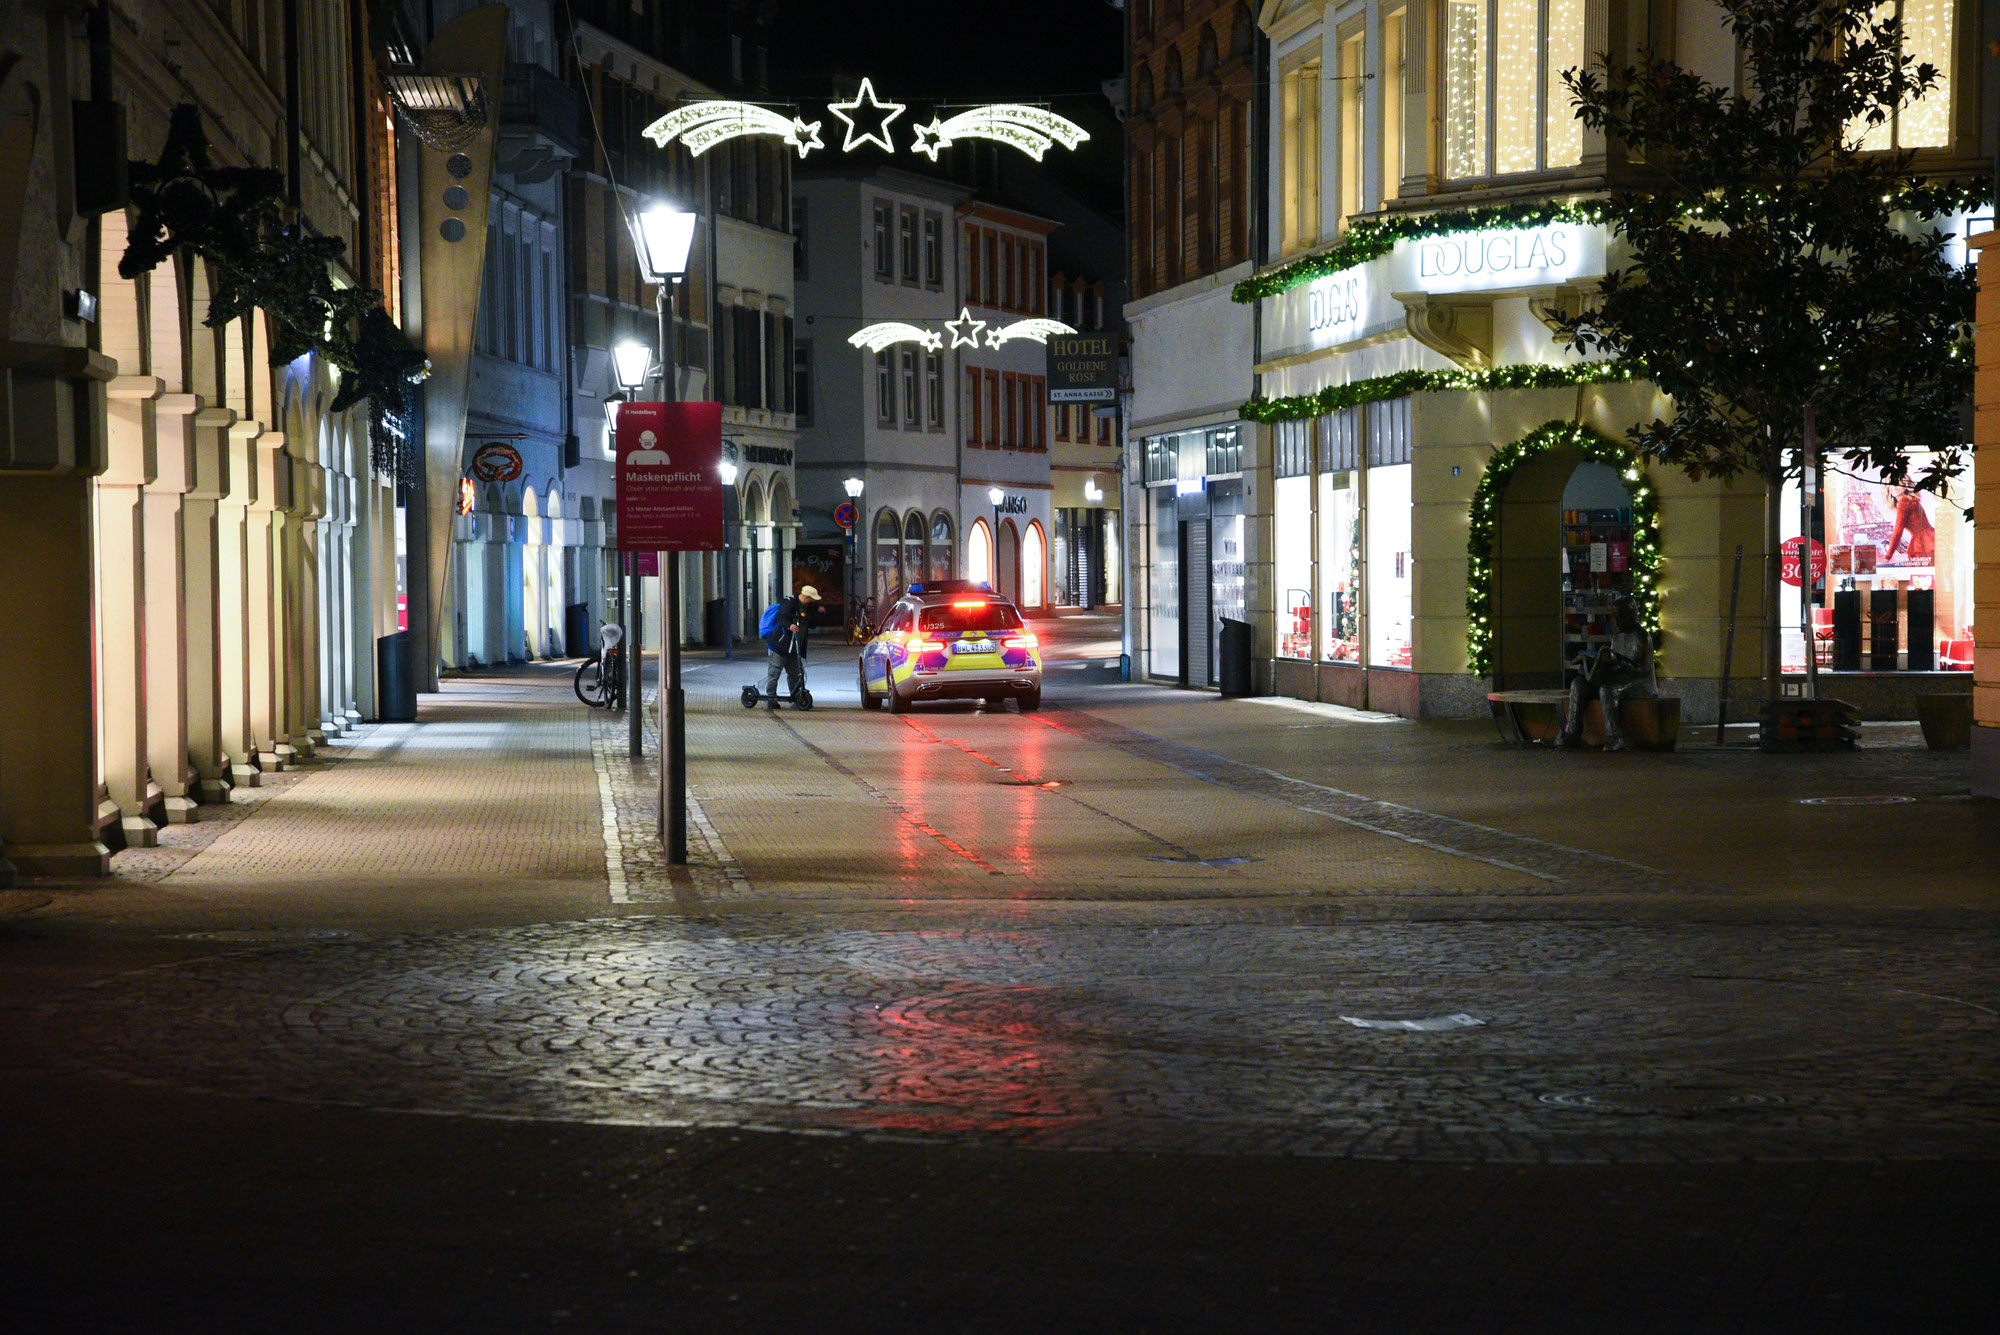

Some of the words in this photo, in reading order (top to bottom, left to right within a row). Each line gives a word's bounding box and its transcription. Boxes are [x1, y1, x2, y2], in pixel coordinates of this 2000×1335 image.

[1420, 230, 1567, 278] DOUGLAS
[1308, 277, 1359, 332] DOUGLAS
[1053, 339, 1112, 356] HOTEL
[1057, 361, 1107, 371] GOLDENE
[1069, 372, 1097, 383] ROSE
[625, 472, 702, 484] Maskenpflicht
[1786, 541, 1804, 550] To
[923, 622, 945, 631] 1/325
[957, 644, 970, 653] BWL
